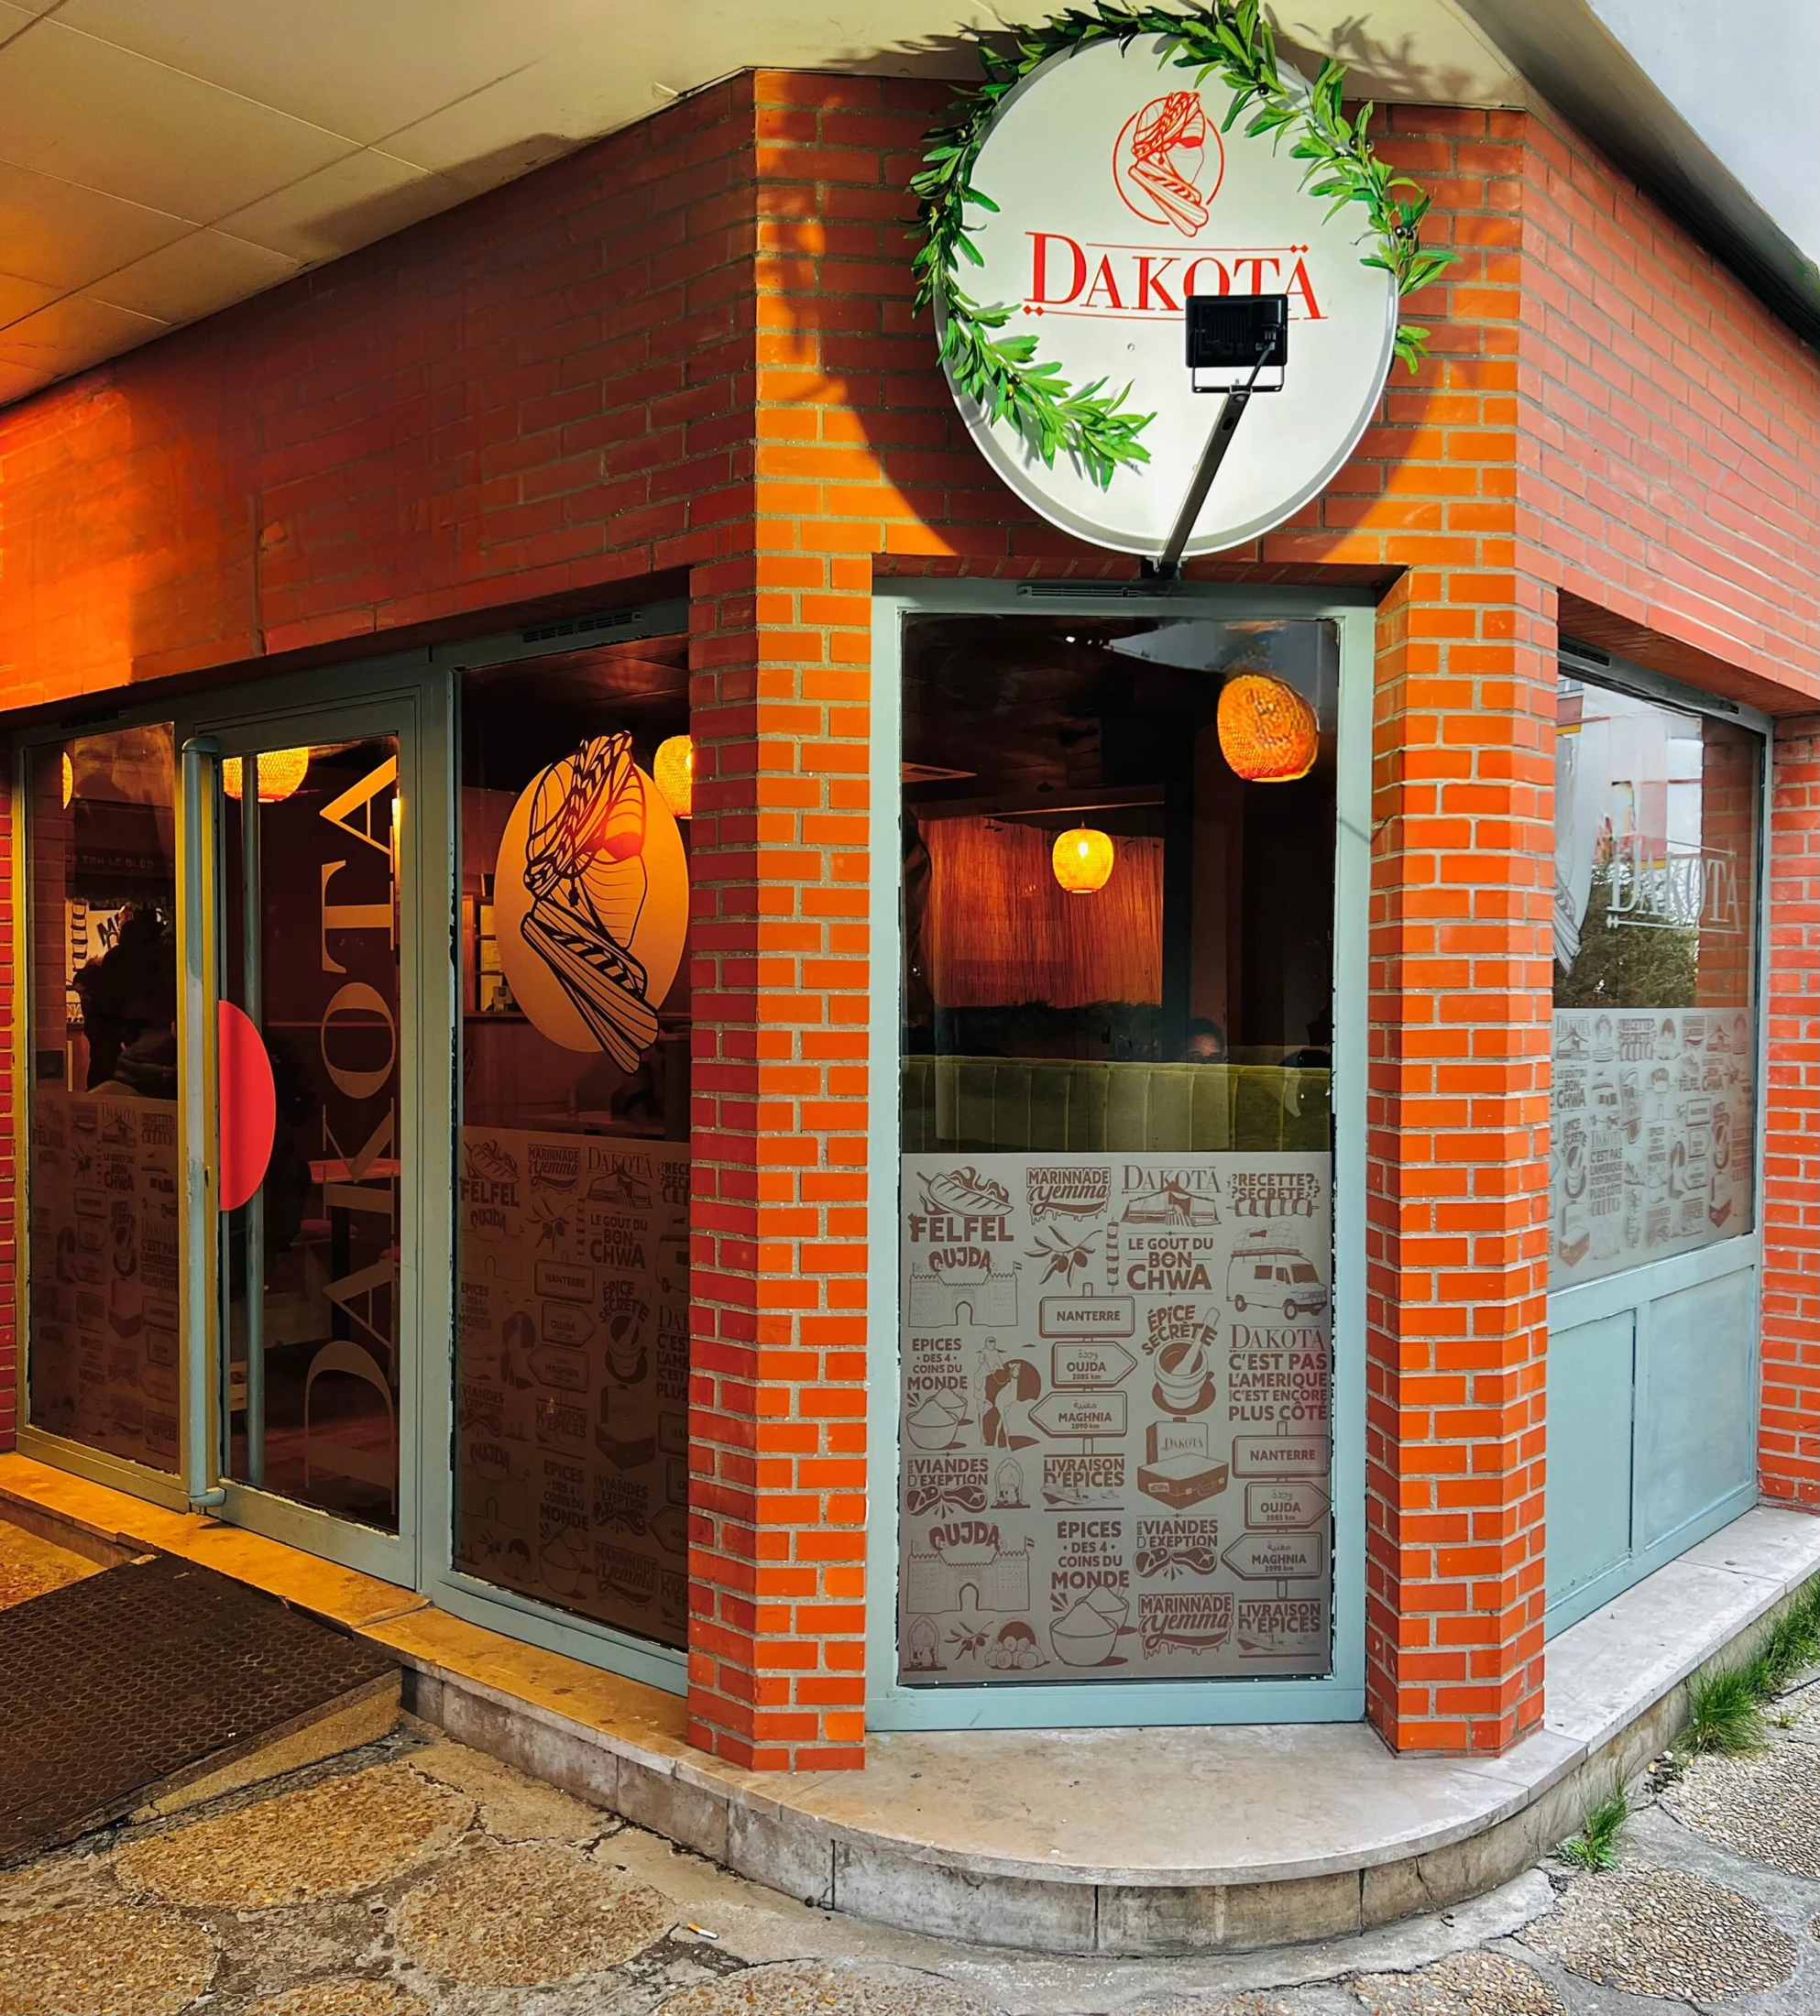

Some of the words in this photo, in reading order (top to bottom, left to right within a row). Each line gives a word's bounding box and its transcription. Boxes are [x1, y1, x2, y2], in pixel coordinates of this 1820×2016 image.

[1024, 231, 1329, 319] DAKOTA
[1606, 835, 1743, 934] DAKOTA
[304, 755, 397, 1516] DAKOTA
[587, 1147, 653, 1179] DAKOTA
[1028, 1170, 1109, 1185] MARINNADE
[1124, 1165, 1222, 1194] DAKOTA
[459, 1178, 521, 1208] FELFEL
[590, 1213, 601, 1225] LE
[604, 1216, 631, 1229] GOUT
[633, 1220, 648, 1232] DU
[909, 1214, 1014, 1242] FELFEL
[604, 1228, 633, 1247] BON
[1128, 1238, 1144, 1250] LE
[1147, 1238, 1189, 1250] GOUT
[1193, 1238, 1213, 1250] DU
[589, 1239, 648, 1270] CHWA
[928, 1246, 992, 1273] OUJDA
[1148, 1252, 1191, 1268] BON
[1126, 1264, 1212, 1290] CHWA
[1056, 1310, 1121, 1321] NANTERRE
[912, 1338, 962, 1352] EPICES
[1229, 1324, 1327, 1352] DAKOTA
[923, 1353, 943, 1363] DES
[944, 1353, 952, 1363] 4
[1229, 1353, 1285, 1371] C'EST
[1288, 1353, 1328, 1371] PAS
[912, 1364, 945, 1375] COINS
[947, 1364, 962, 1375] DU
[1067, 1361, 1107, 1373] OUJDA
[907, 1375, 969, 1390] MONDE
[1091, 1373, 1102, 1381] km
[1229, 1373, 1328, 1389] L'AMERIQUE
[1233, 1389, 1269, 1402] C'EST
[1273, 1390, 1328, 1402] ENCORE
[1058, 1412, 1112, 1423] MAGHNIA
[1229, 1406, 1274, 1421] PLUS
[1278, 1401, 1328, 1421] CÔTÉ
[1162, 1437, 1204, 1450] DAKOTA
[1250, 1450, 1316, 1461] NANTERRE
[914, 1458, 989, 1474] VIANDES
[1044, 1459, 1124, 1472] LIVRAISON
[907, 1474, 989, 1487] D'EXEPTION
[1044, 1471, 1124, 1488] D'EPICES
[1260, 1503, 1301, 1513] OUJDA
[541, 1503, 588, 1531] MONDE
[928, 1520, 1001, 1550] OUJDA
[1144, 1519, 1219, 1535] VIANDES
[1070, 1541, 1097, 1553] DES
[1099, 1541, 1108, 1553] 4
[1137, 1535, 1218, 1549] D'EXEPTION
[1058, 1555, 1100, 1568] COINS
[1102, 1555, 1123, 1568] DU
[1252, 1554, 1307, 1565] MAGHNIA
[1051, 1571, 1130, 1589] MONDE
[1140, 1595, 1232, 1613] MARINNADE
[1238, 1603, 1320, 1617] LIVRAISON
[1238, 1616, 1320, 1632] D'EPICES
